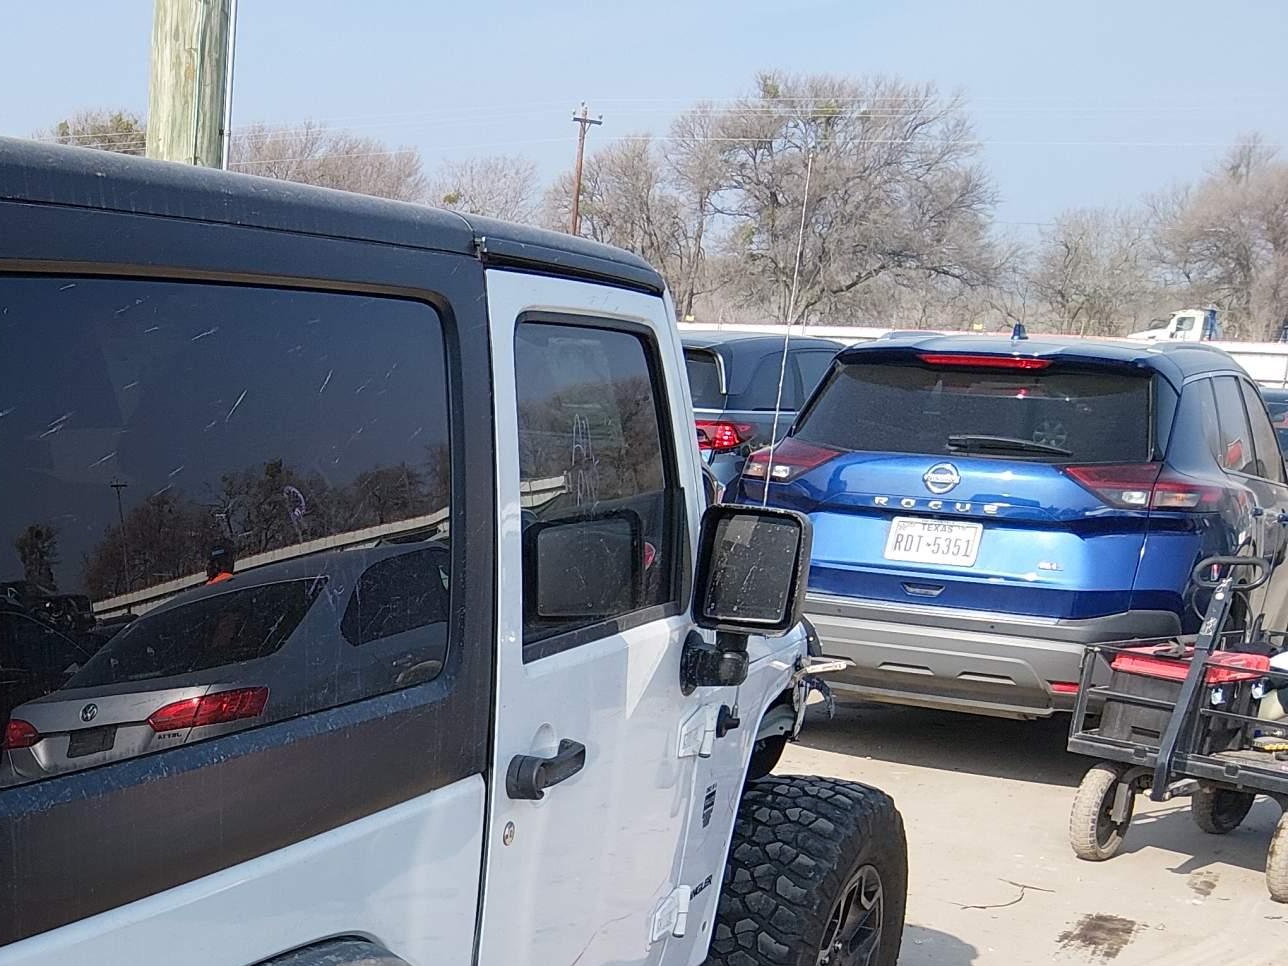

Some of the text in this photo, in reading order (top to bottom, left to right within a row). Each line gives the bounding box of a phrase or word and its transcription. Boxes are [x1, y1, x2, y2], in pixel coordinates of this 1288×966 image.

[874, 496, 999, 514] ROGUE
[922, 523, 953, 533] TEXAS
[690, 874, 713, 901] NGLER
